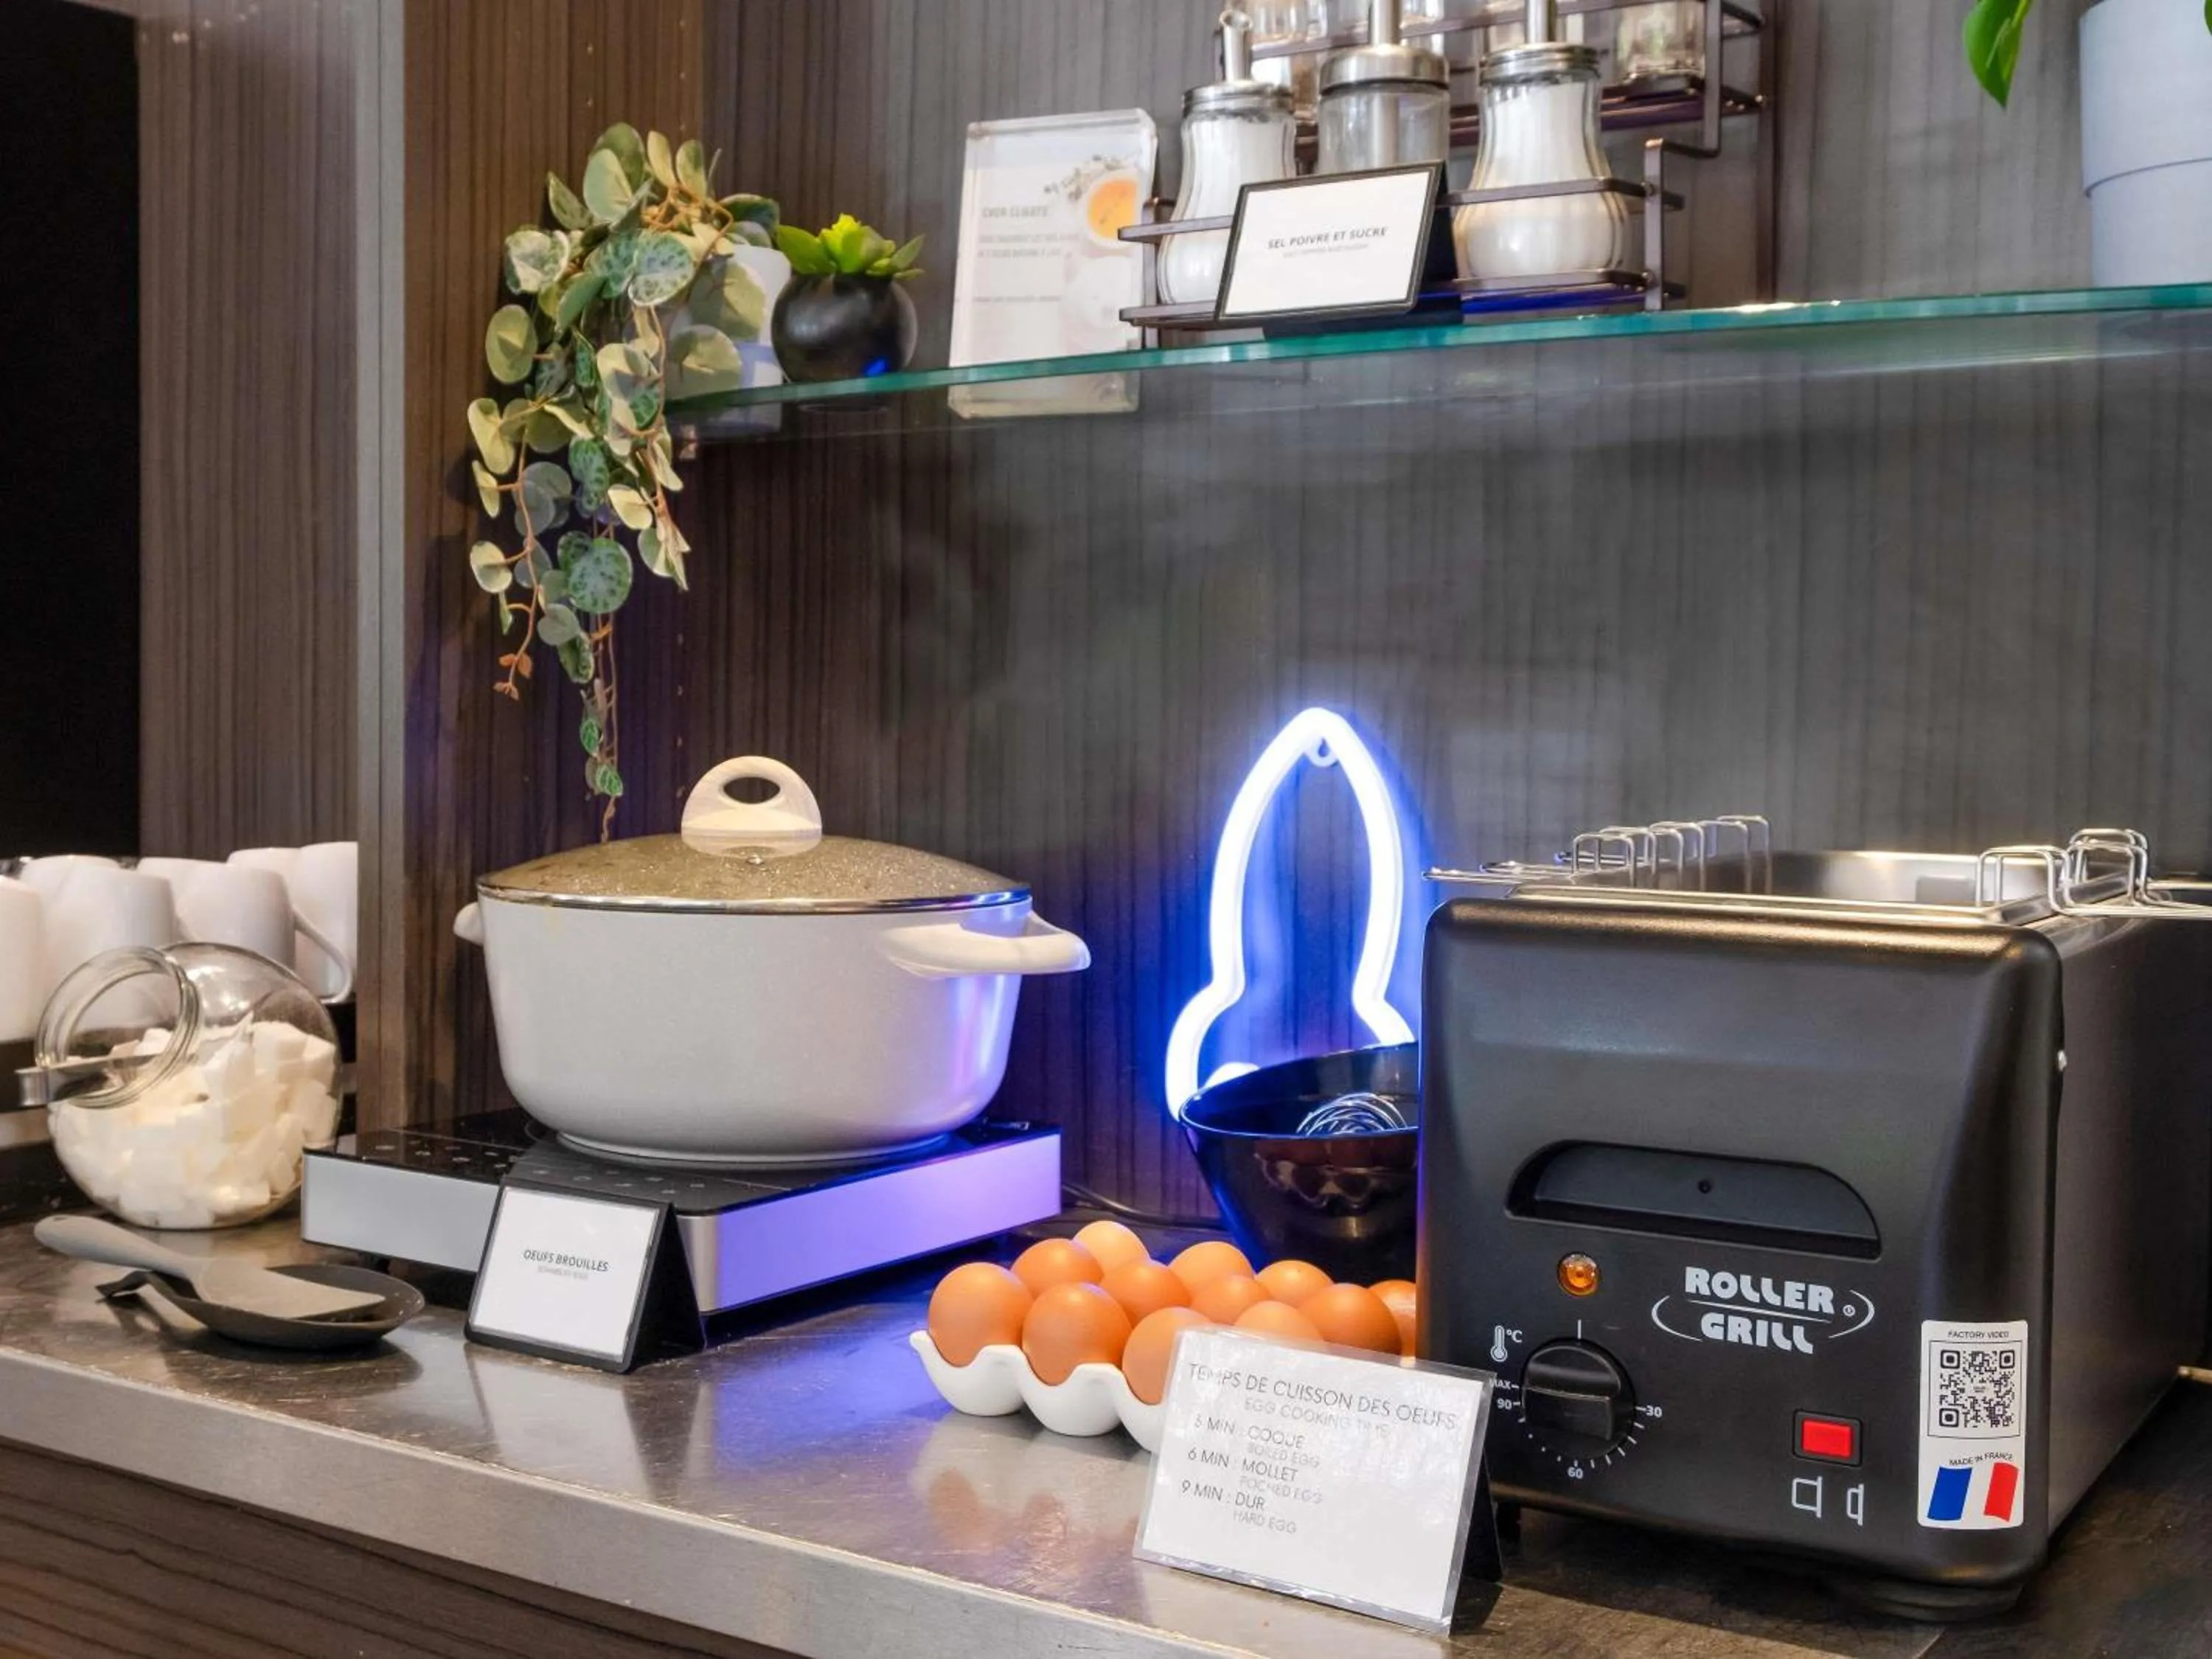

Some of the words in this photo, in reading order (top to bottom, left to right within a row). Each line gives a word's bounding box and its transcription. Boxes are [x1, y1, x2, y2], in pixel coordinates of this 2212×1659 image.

[1268, 237, 1285, 249] SEL
[1290, 233, 1329, 246] POIVRE
[1333, 231, 1346, 241] ET
[1349, 227, 1388, 239] SUCRE
[524, 1250, 554, 1263] OEUFS
[555, 1254, 608, 1271] BROUILLES
[1685, 1266, 1834, 1315] ROLLER
[1506, 1329, 1523, 1343] °C
[1700, 1312, 1813, 1354] GRILL
[1245, 1374, 1269, 1393] DE
[1274, 1380, 1353, 1410] CUISSON
[1358, 1397, 1390, 1416] DES
[1397, 1405, 1456, 1430] OEUFS
[1245, 1397, 1276, 1413] EGG
[1280, 1405, 1350, 1429] COOKING
[1498, 1398, 1512, 1410] 90
[1646, 1405, 1663, 1418] 30
[1206, 1417, 1236, 1434] MIN
[1248, 1426, 1305, 1448] COQUE
[1188, 1447, 1197, 1460] 6
[1201, 1450, 1229, 1467] MIN
[1242, 1458, 1298, 1482] MOLLET
[1949, 1457, 1974, 1466] MADE
[1984, 1451, 2012, 1461] FRANCE
[1568, 1467, 1583, 1479] 60
[1182, 1480, 1191, 1493] 9
[1194, 1483, 1223, 1501] MIN
[1235, 1492, 1265, 1510] DUR
[1234, 1510, 1265, 1526] HARD
[1268, 1517, 1296, 1534] EGG
